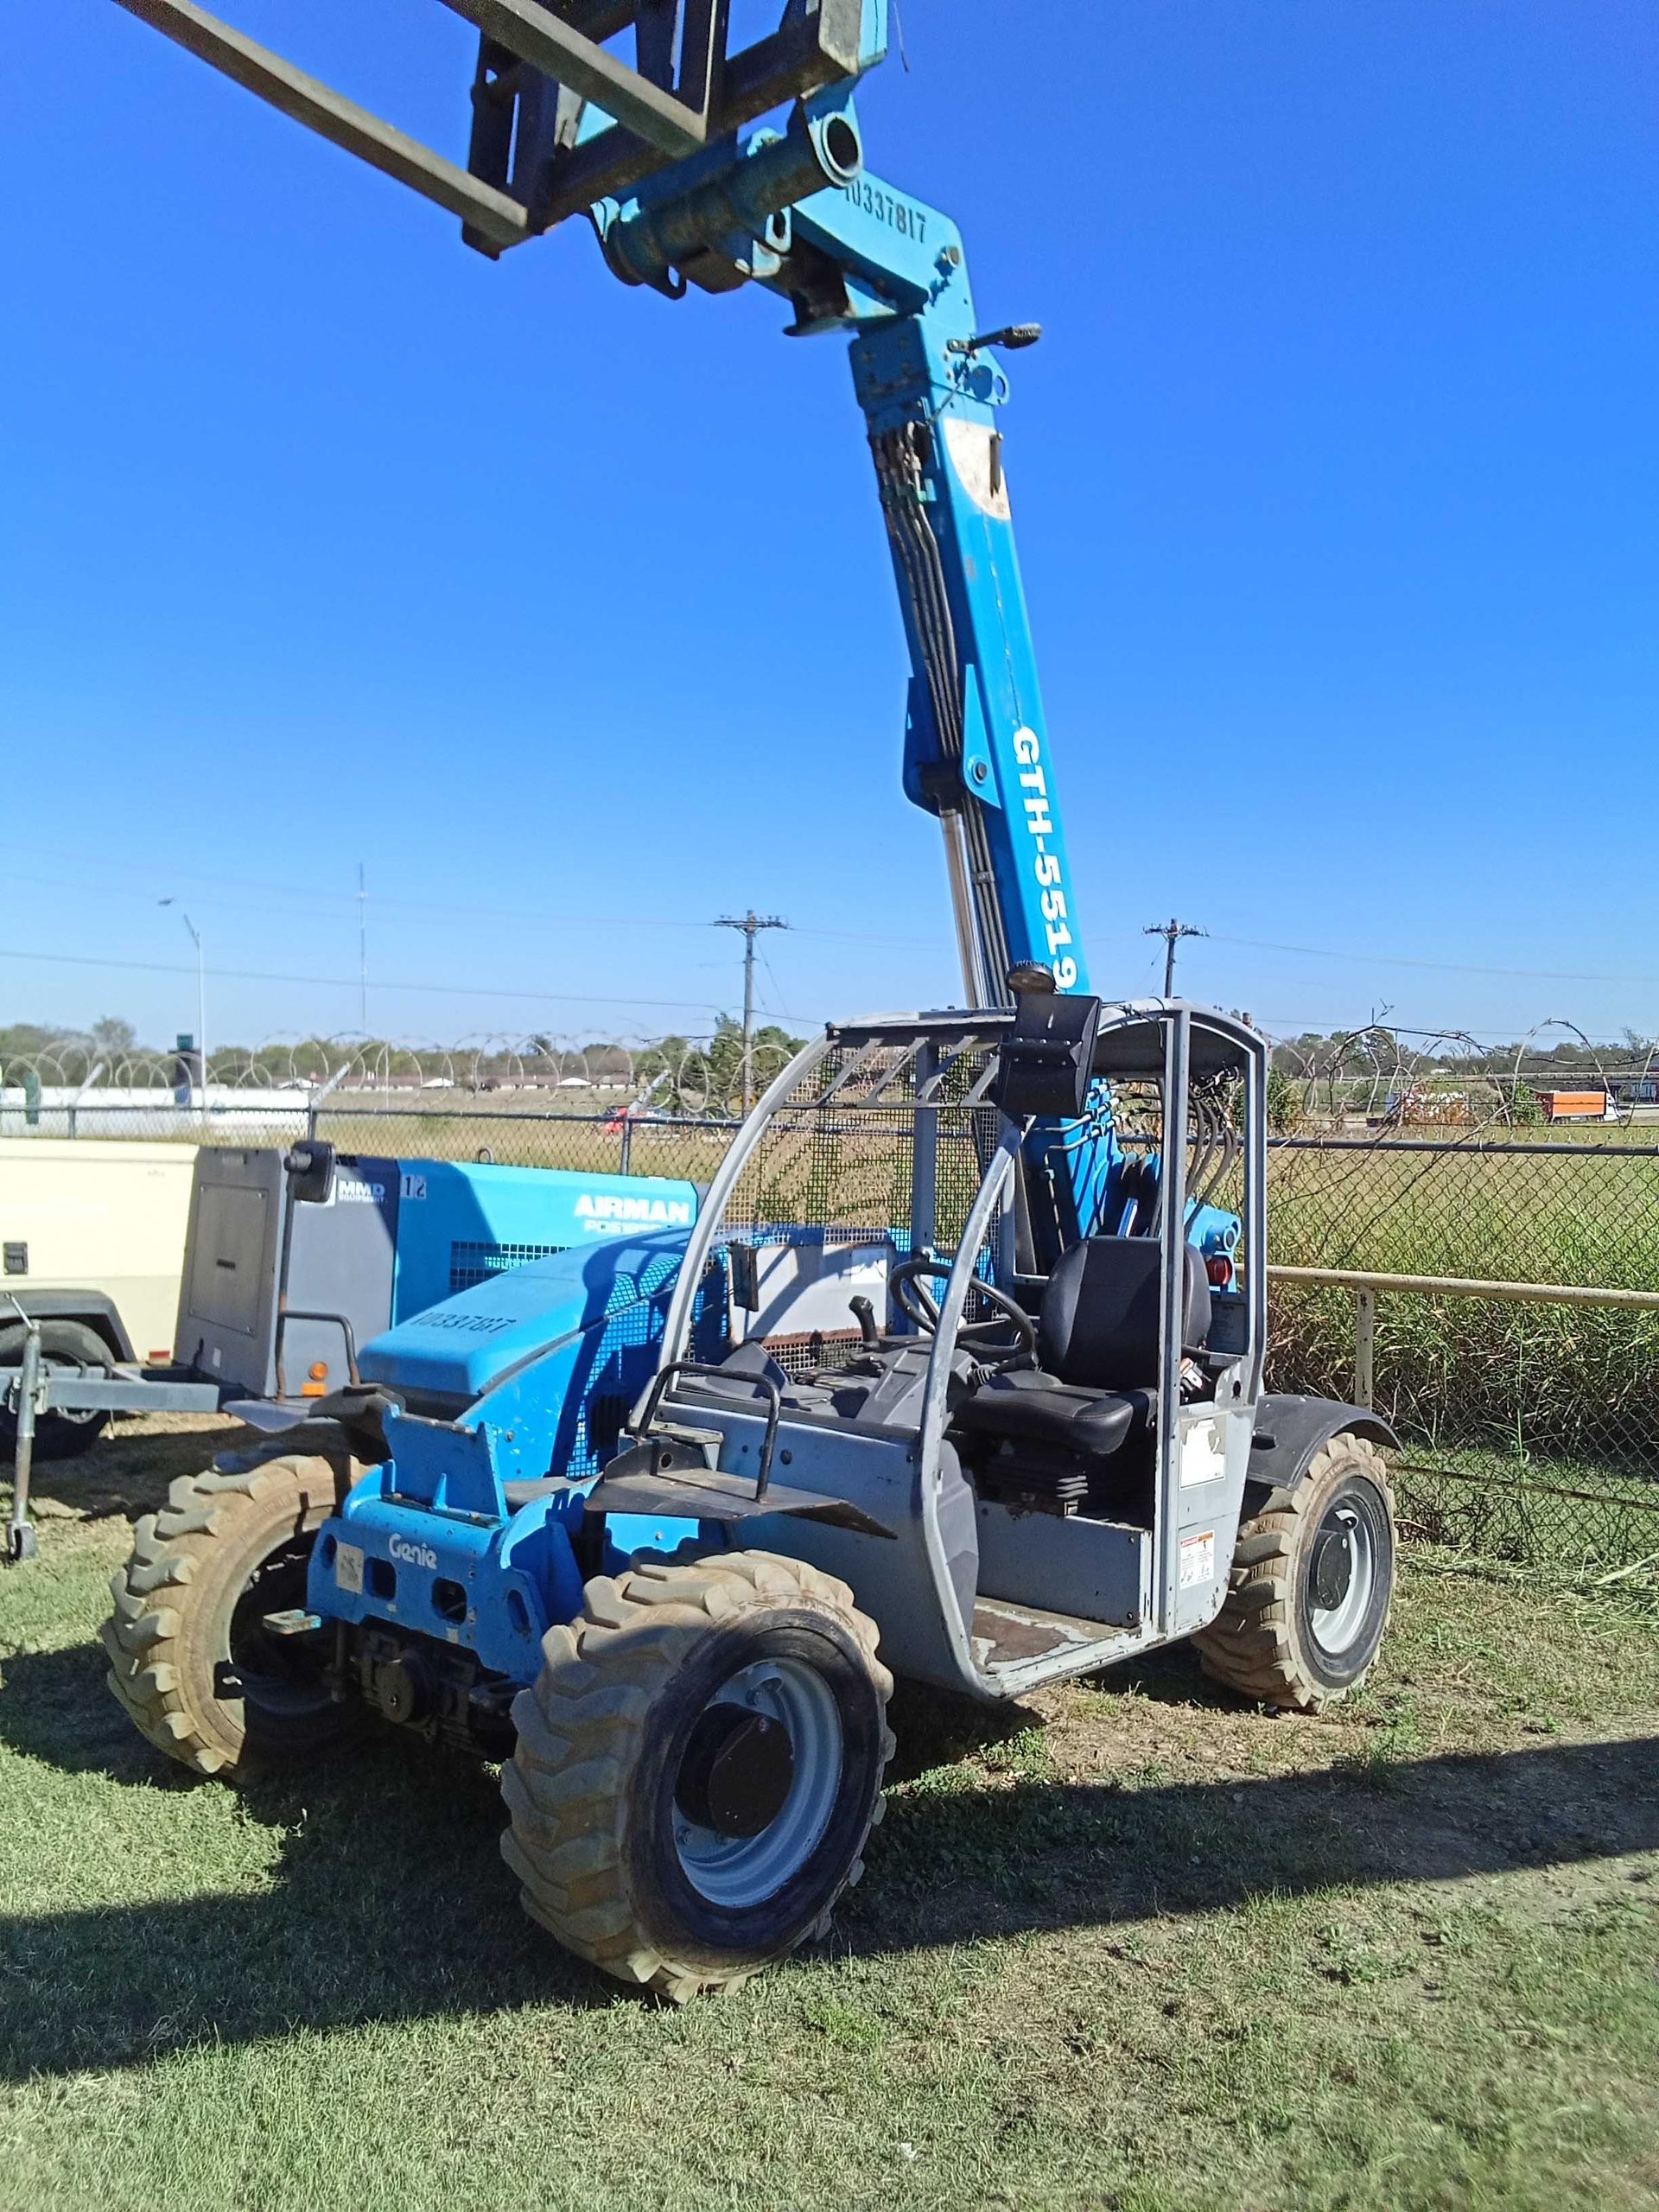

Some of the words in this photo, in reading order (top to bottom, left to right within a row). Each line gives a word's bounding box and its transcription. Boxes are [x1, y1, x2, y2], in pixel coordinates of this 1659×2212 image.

[1013, 725, 1077, 989] GTH-5519
[338, 1180, 385, 1196] MMD
[574, 1194, 690, 1224] AIRMAN
[389, 1532, 437, 1570] Genie
